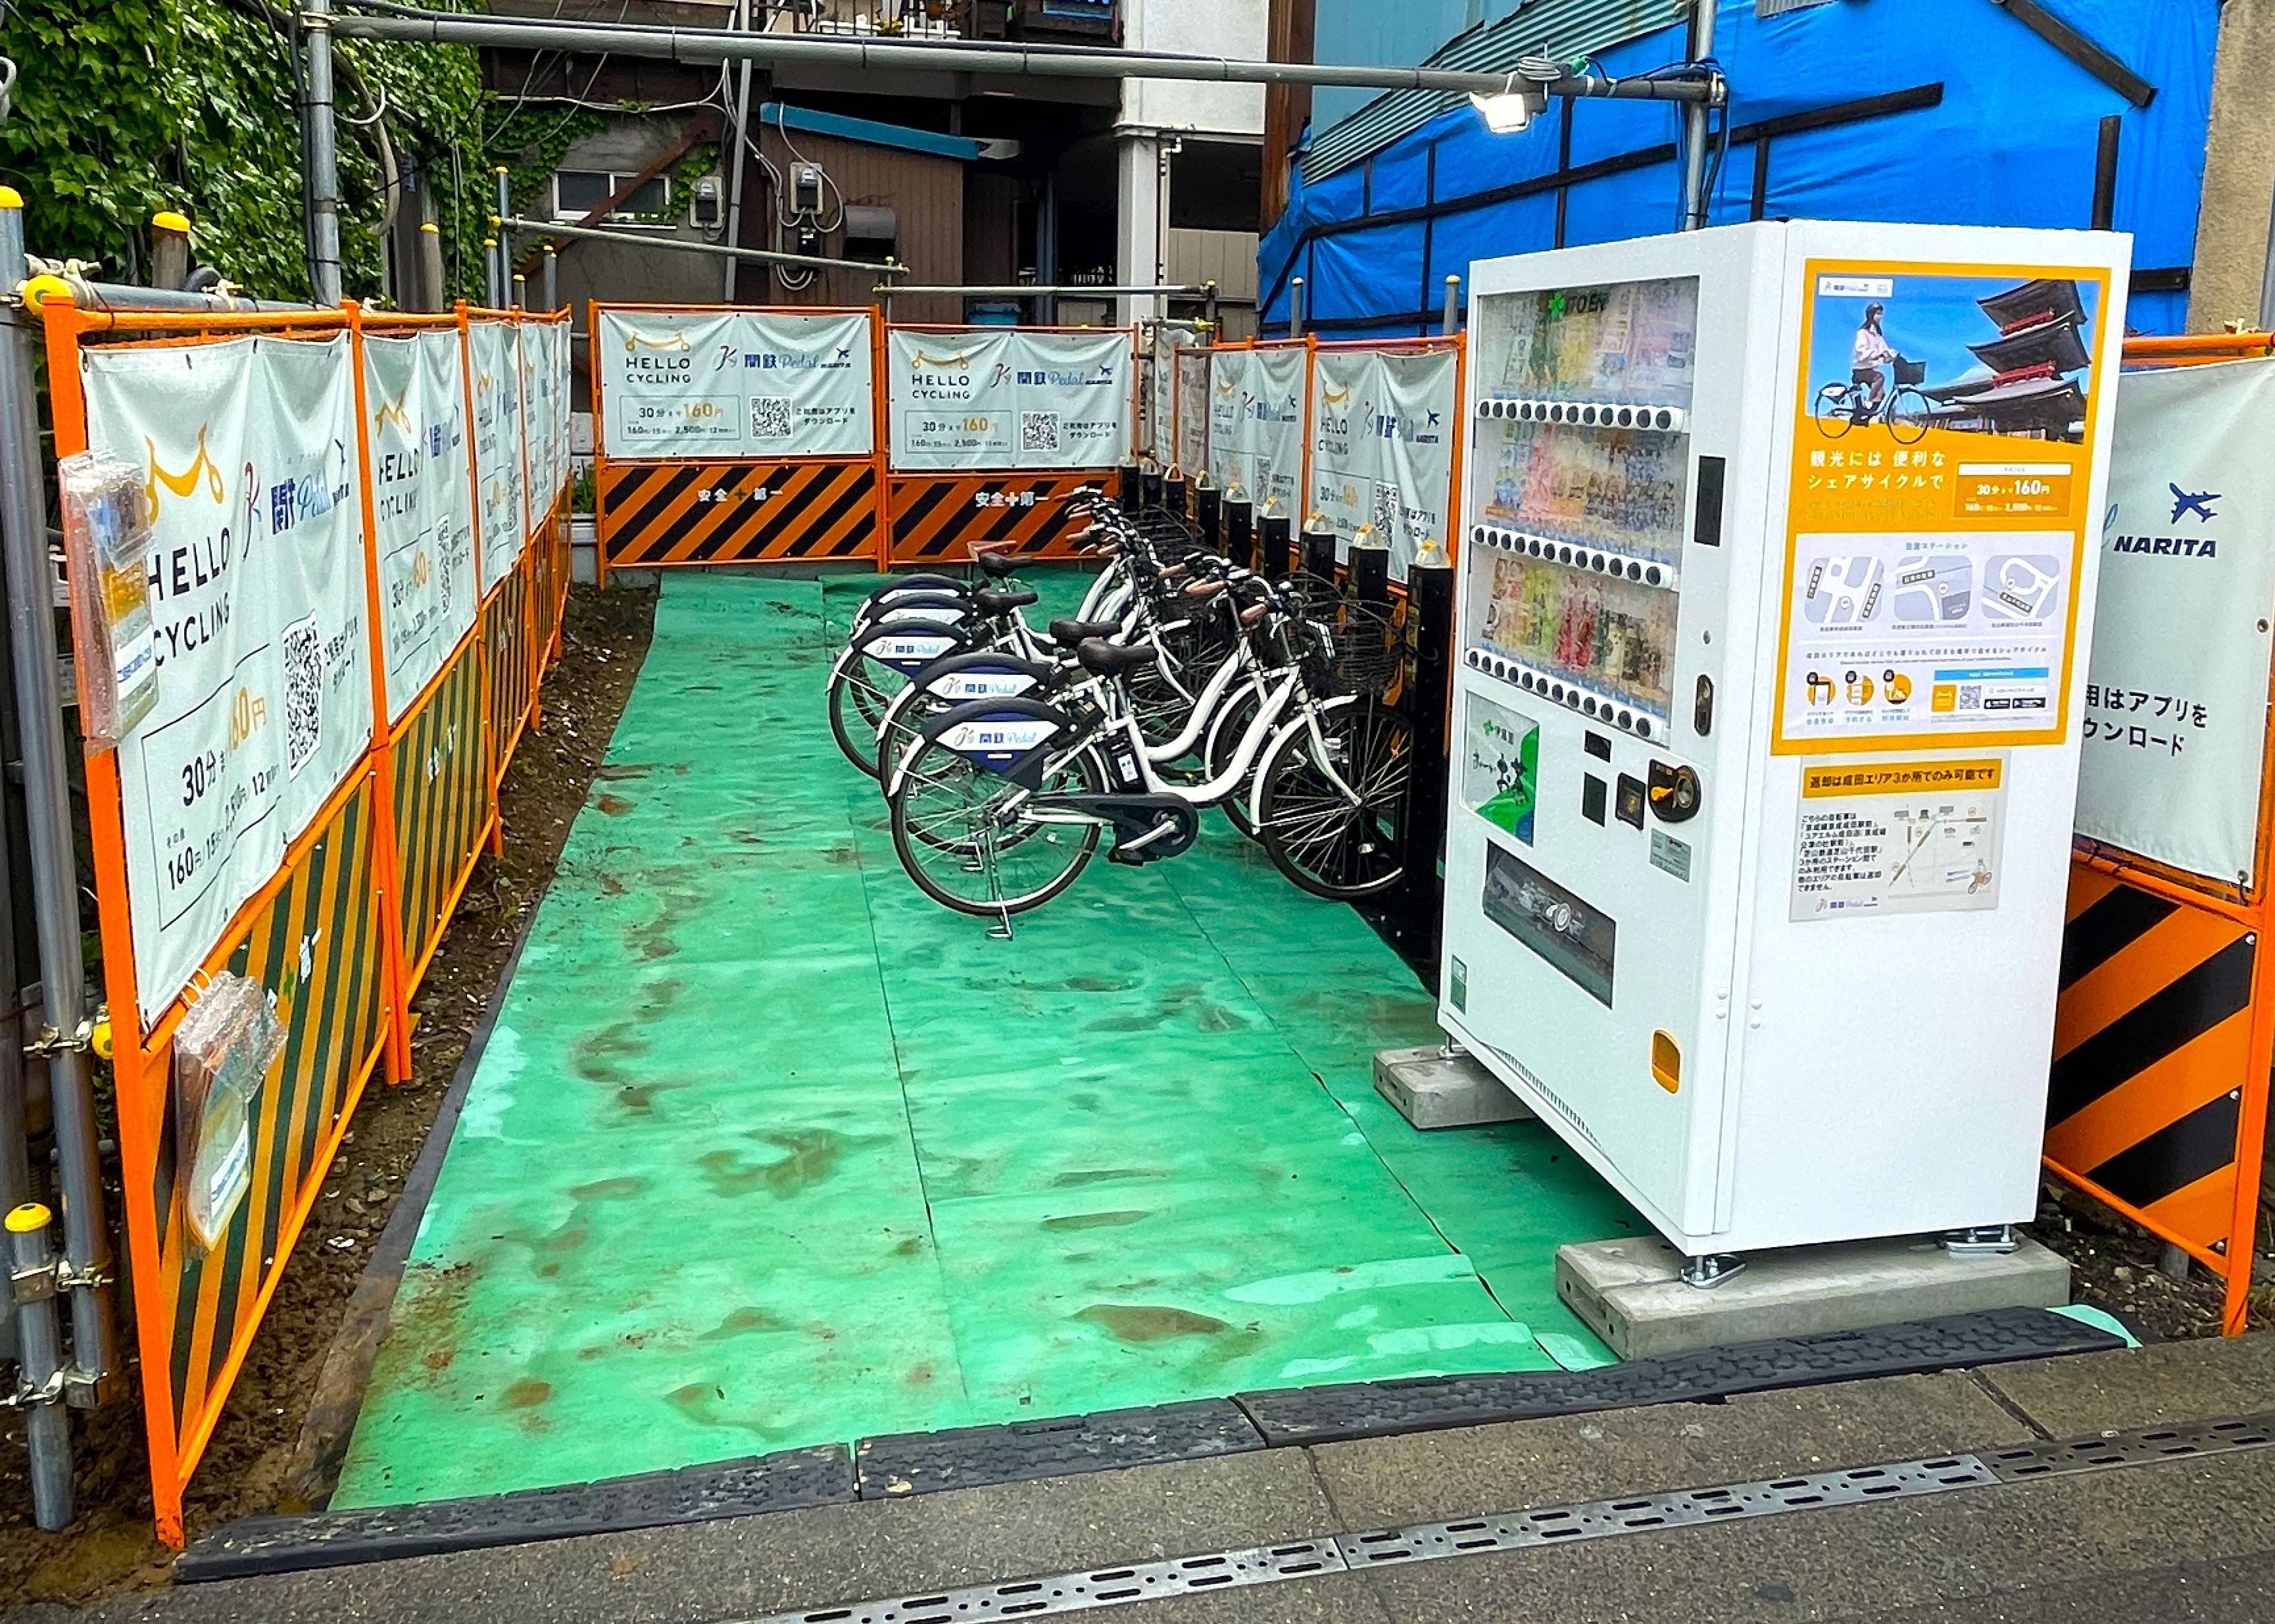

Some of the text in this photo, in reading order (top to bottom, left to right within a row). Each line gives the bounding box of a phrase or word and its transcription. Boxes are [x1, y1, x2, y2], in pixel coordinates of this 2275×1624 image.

[625, 357, 690, 369] HELLO
[626, 374, 691, 383] CYCLING
[912, 375, 970, 386] HELLO
[912, 391, 970, 399] CYCLING
[1810, 450, 1946, 468] 観光には 便利な
[1808, 473, 1944, 489] シェアサイクルで
[2113, 535, 2217, 558] NARITA
